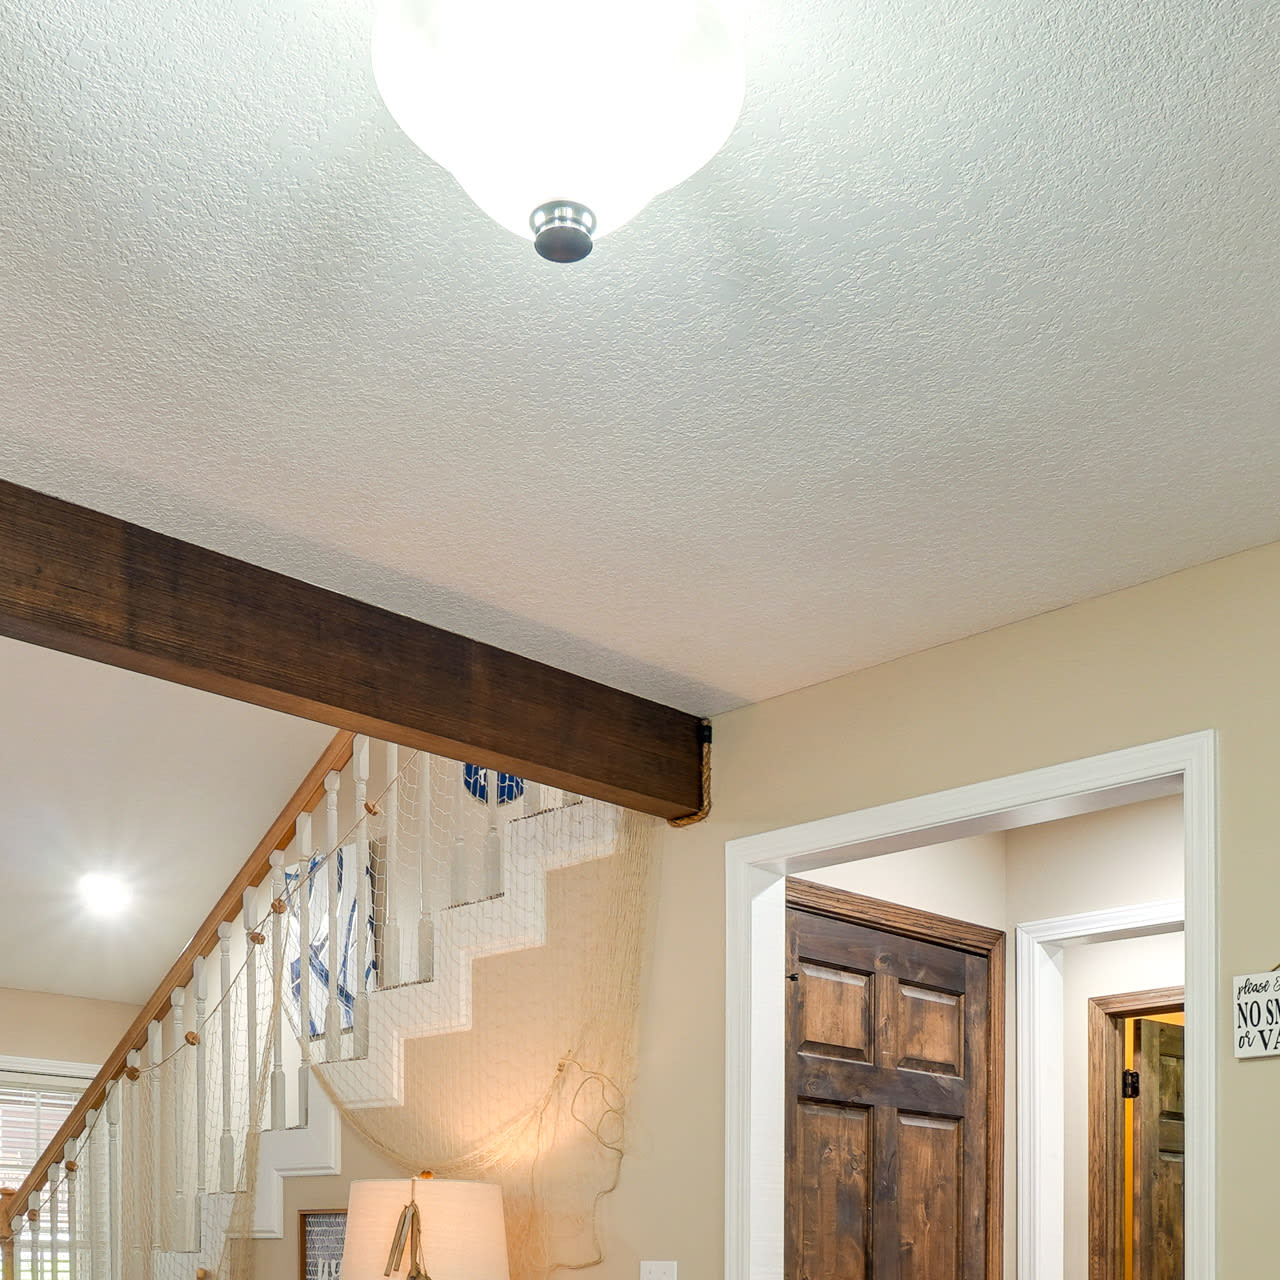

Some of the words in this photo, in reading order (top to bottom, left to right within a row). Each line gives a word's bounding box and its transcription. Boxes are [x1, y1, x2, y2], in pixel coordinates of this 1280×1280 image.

[1237, 978, 1270, 1000] please
[1237, 1000, 1261, 1029] NO
[1238, 1030, 1256, 1049] or
